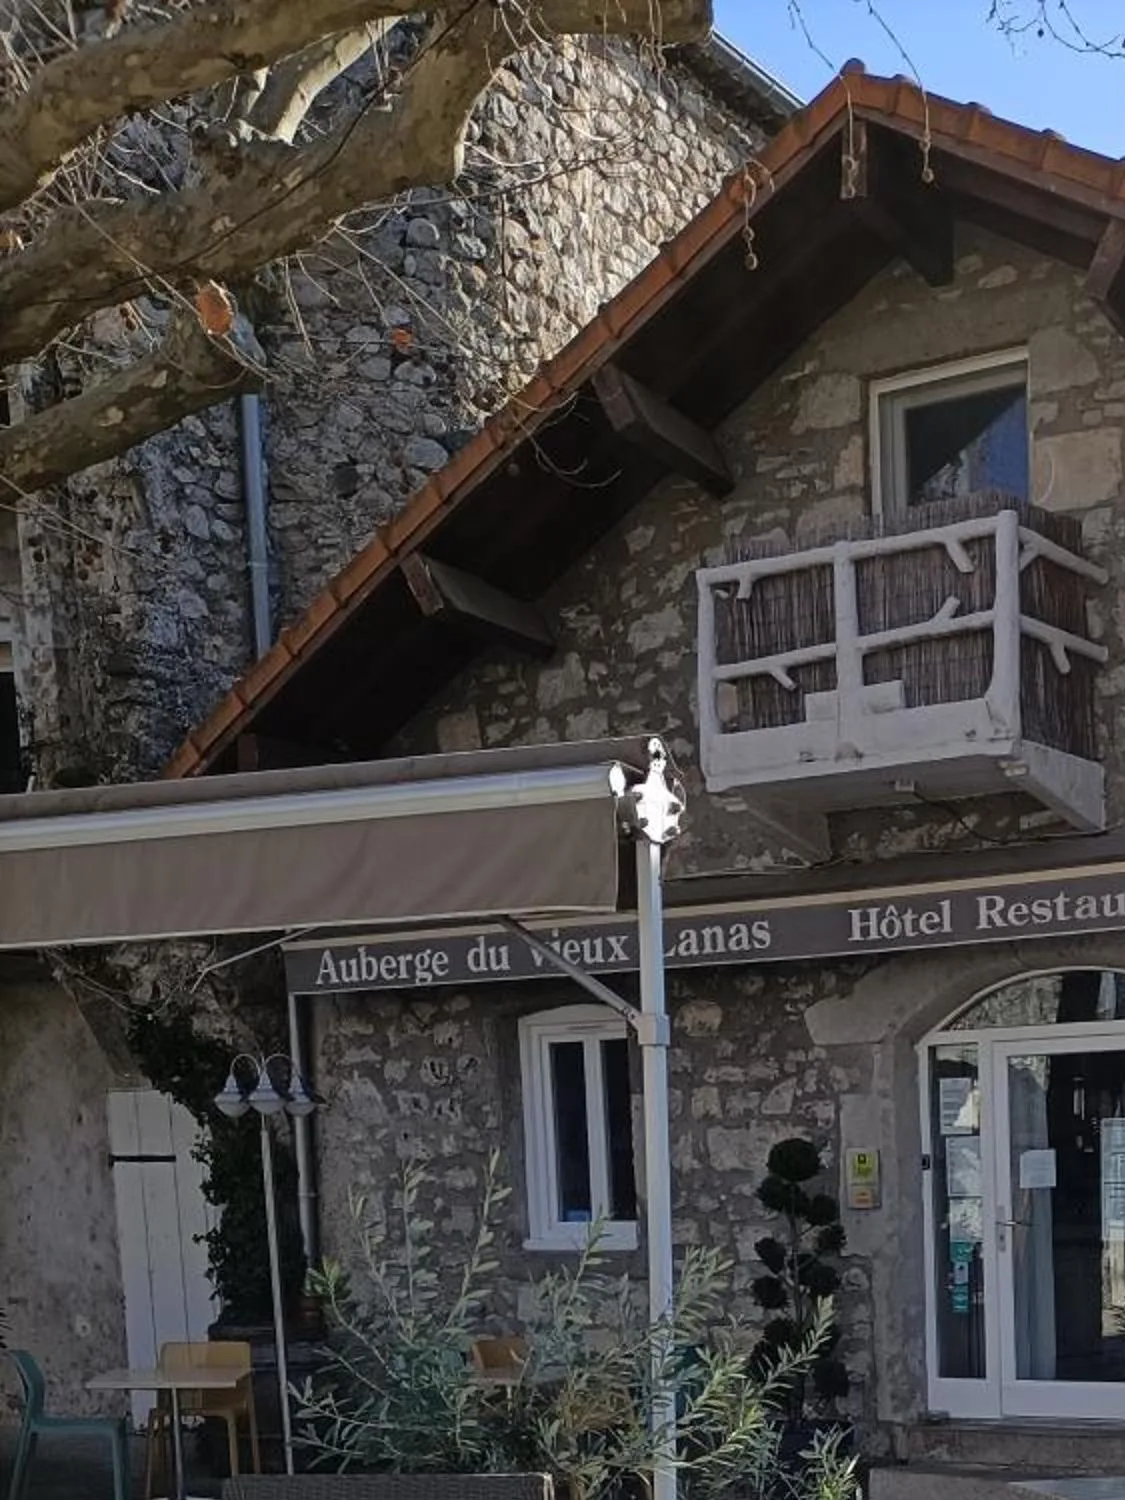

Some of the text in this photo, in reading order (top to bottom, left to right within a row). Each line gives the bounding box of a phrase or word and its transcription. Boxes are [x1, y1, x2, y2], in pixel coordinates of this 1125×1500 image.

[848, 902, 952, 942] Hôtel
[316, 946, 449, 985] Auberge
[467, 936, 510, 972] du
[662, 920, 771, 957] anas
